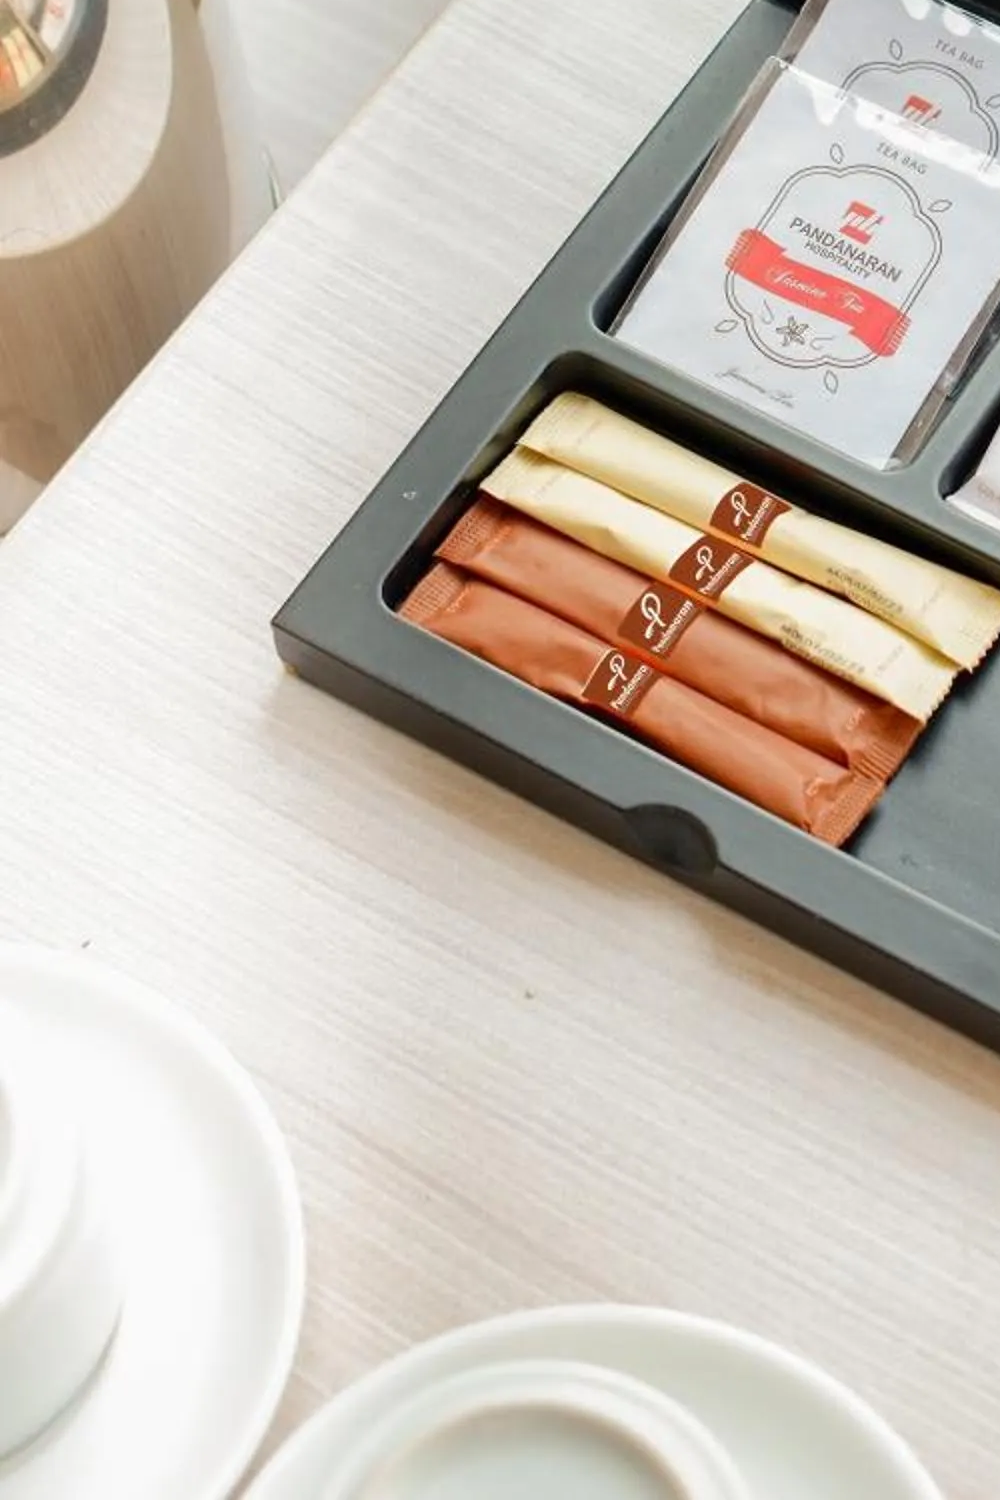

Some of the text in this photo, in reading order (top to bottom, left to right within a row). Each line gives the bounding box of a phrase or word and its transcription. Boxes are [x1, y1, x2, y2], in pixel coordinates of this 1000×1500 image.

[934, 38, 986, 70] TEA BAG
[876, 141, 928, 175] TEA BAG
[789, 216, 903, 283] PANDANARAN
[804, 240, 871, 279] HOSPITALITY
